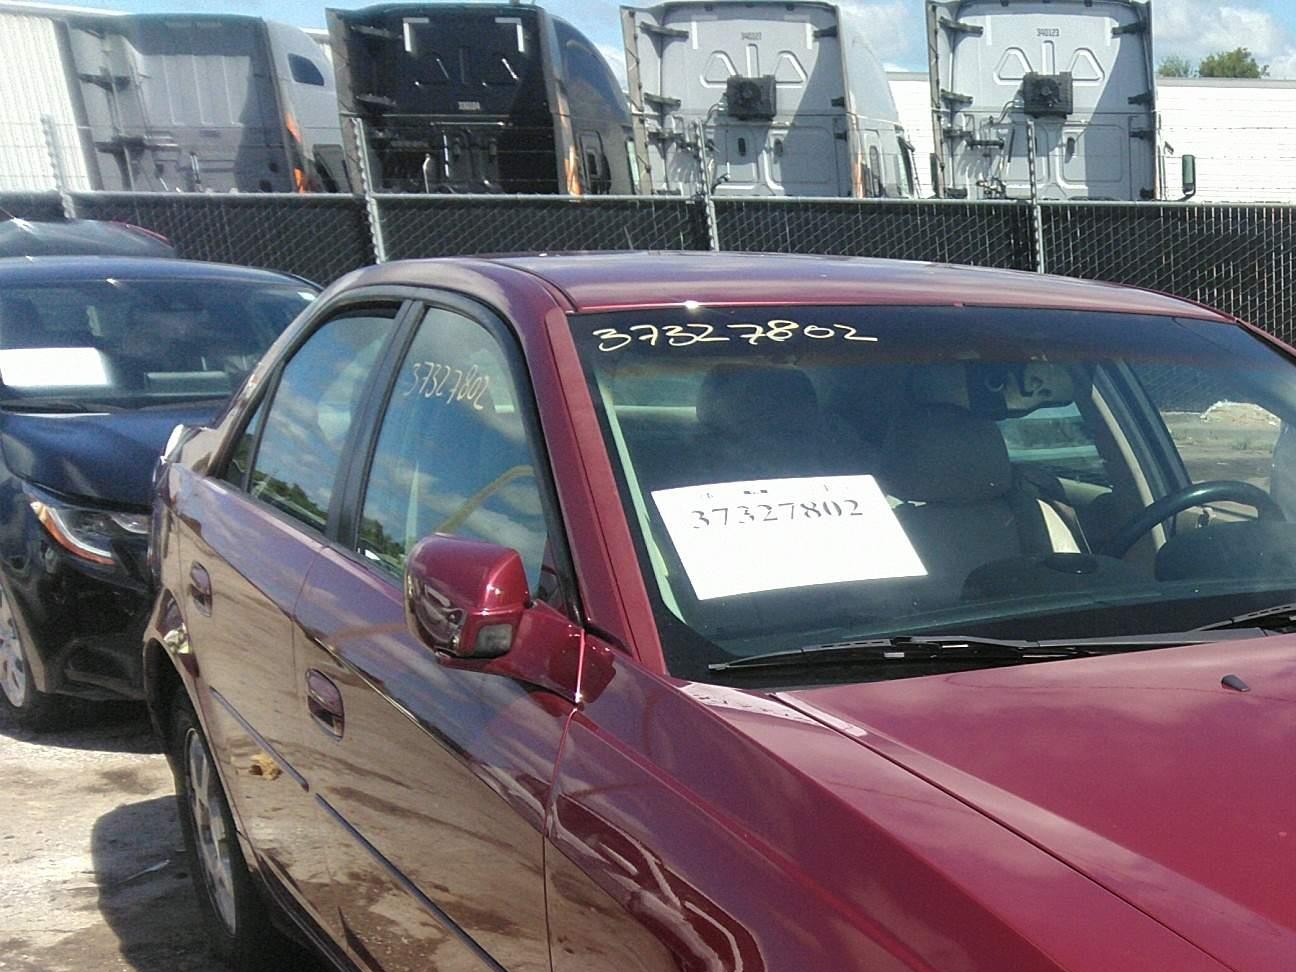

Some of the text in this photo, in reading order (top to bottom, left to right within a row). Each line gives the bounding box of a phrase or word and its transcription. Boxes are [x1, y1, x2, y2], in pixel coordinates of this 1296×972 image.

[592, 319, 879, 351] 37327802
[403, 361, 490, 411] 37327802
[692, 499, 863, 529] 37327802
